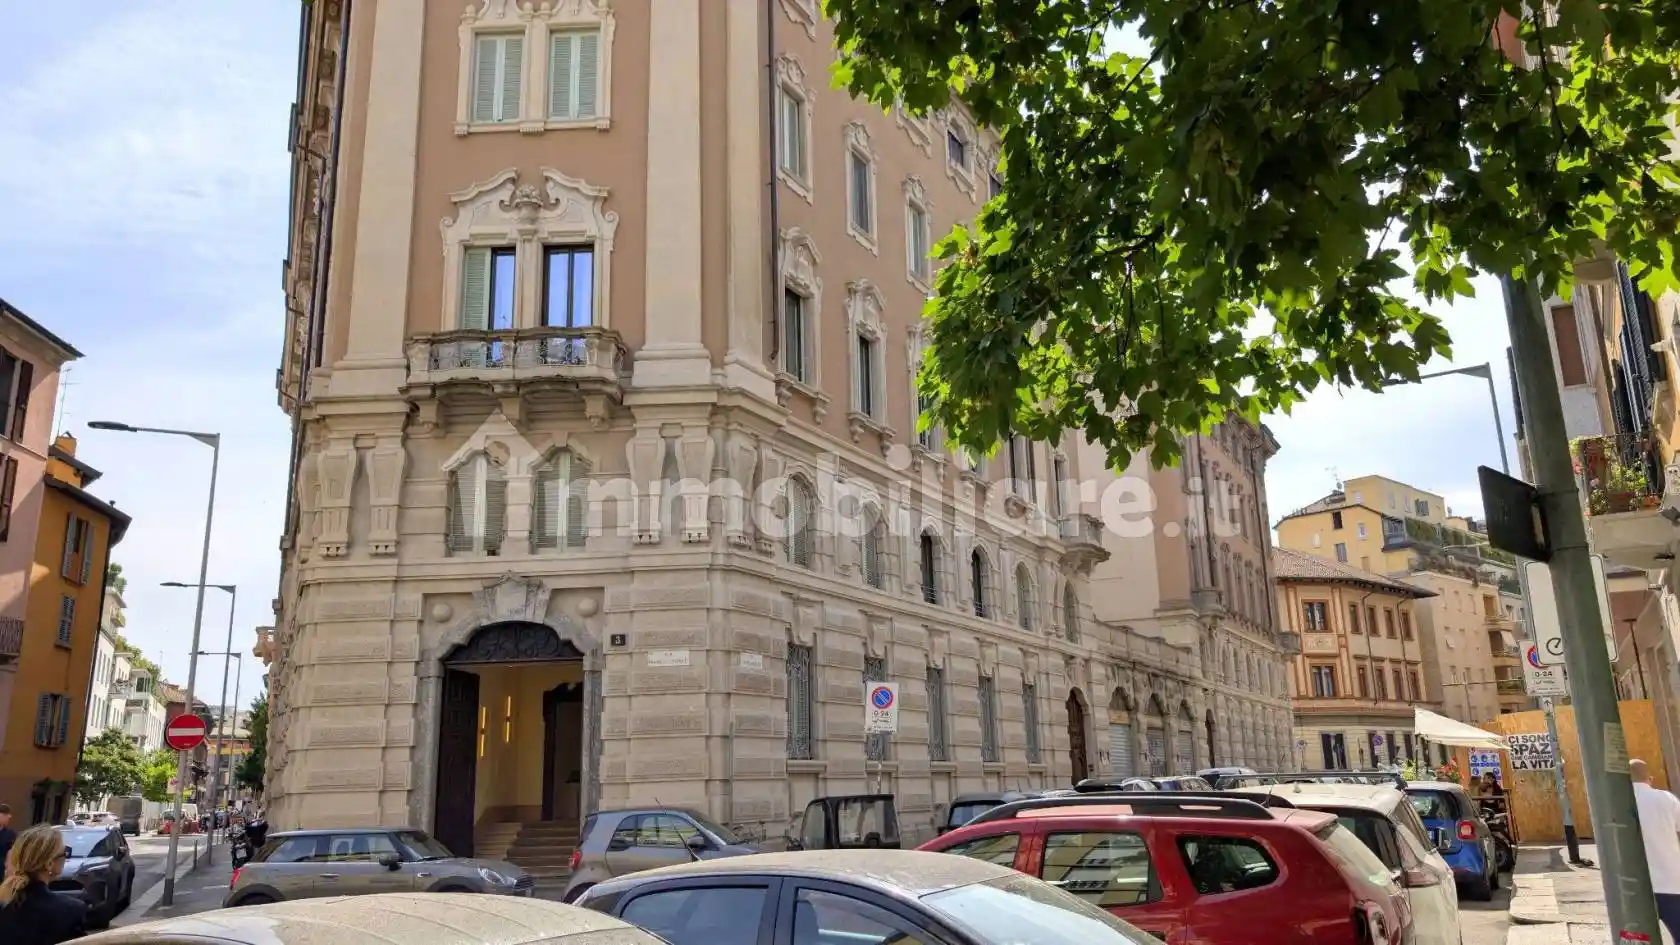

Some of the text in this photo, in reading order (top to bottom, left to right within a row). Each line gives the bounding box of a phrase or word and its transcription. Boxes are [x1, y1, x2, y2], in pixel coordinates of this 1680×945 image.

[1508, 735, 1519, 743] CI
[1510, 742, 1552, 755] SPAZ
[1512, 760, 1528, 769] LA
